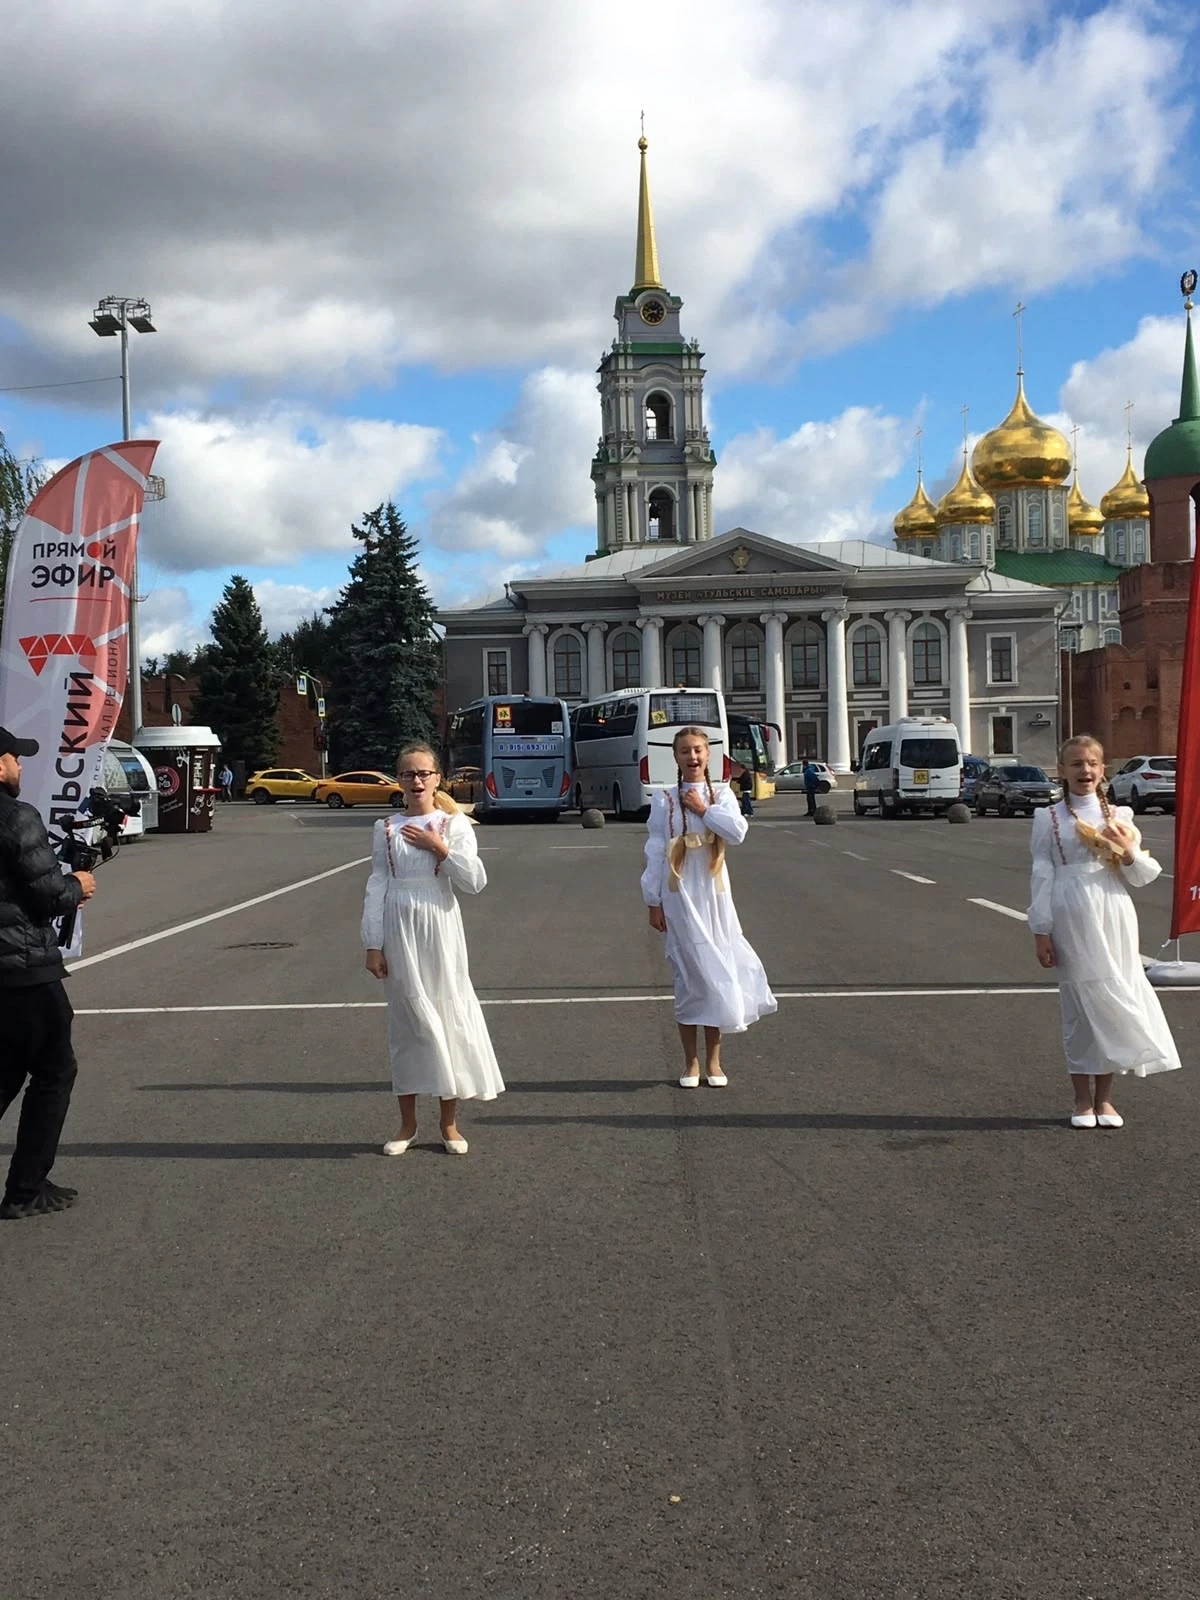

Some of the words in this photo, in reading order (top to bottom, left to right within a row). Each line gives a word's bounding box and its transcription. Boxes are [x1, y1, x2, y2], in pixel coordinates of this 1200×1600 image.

[33, 539, 116, 559] ПРЯМОЙ
[31, 564, 115, 588] ЭФИР
[48, 671, 94, 849] УЛЬСКИЙ
